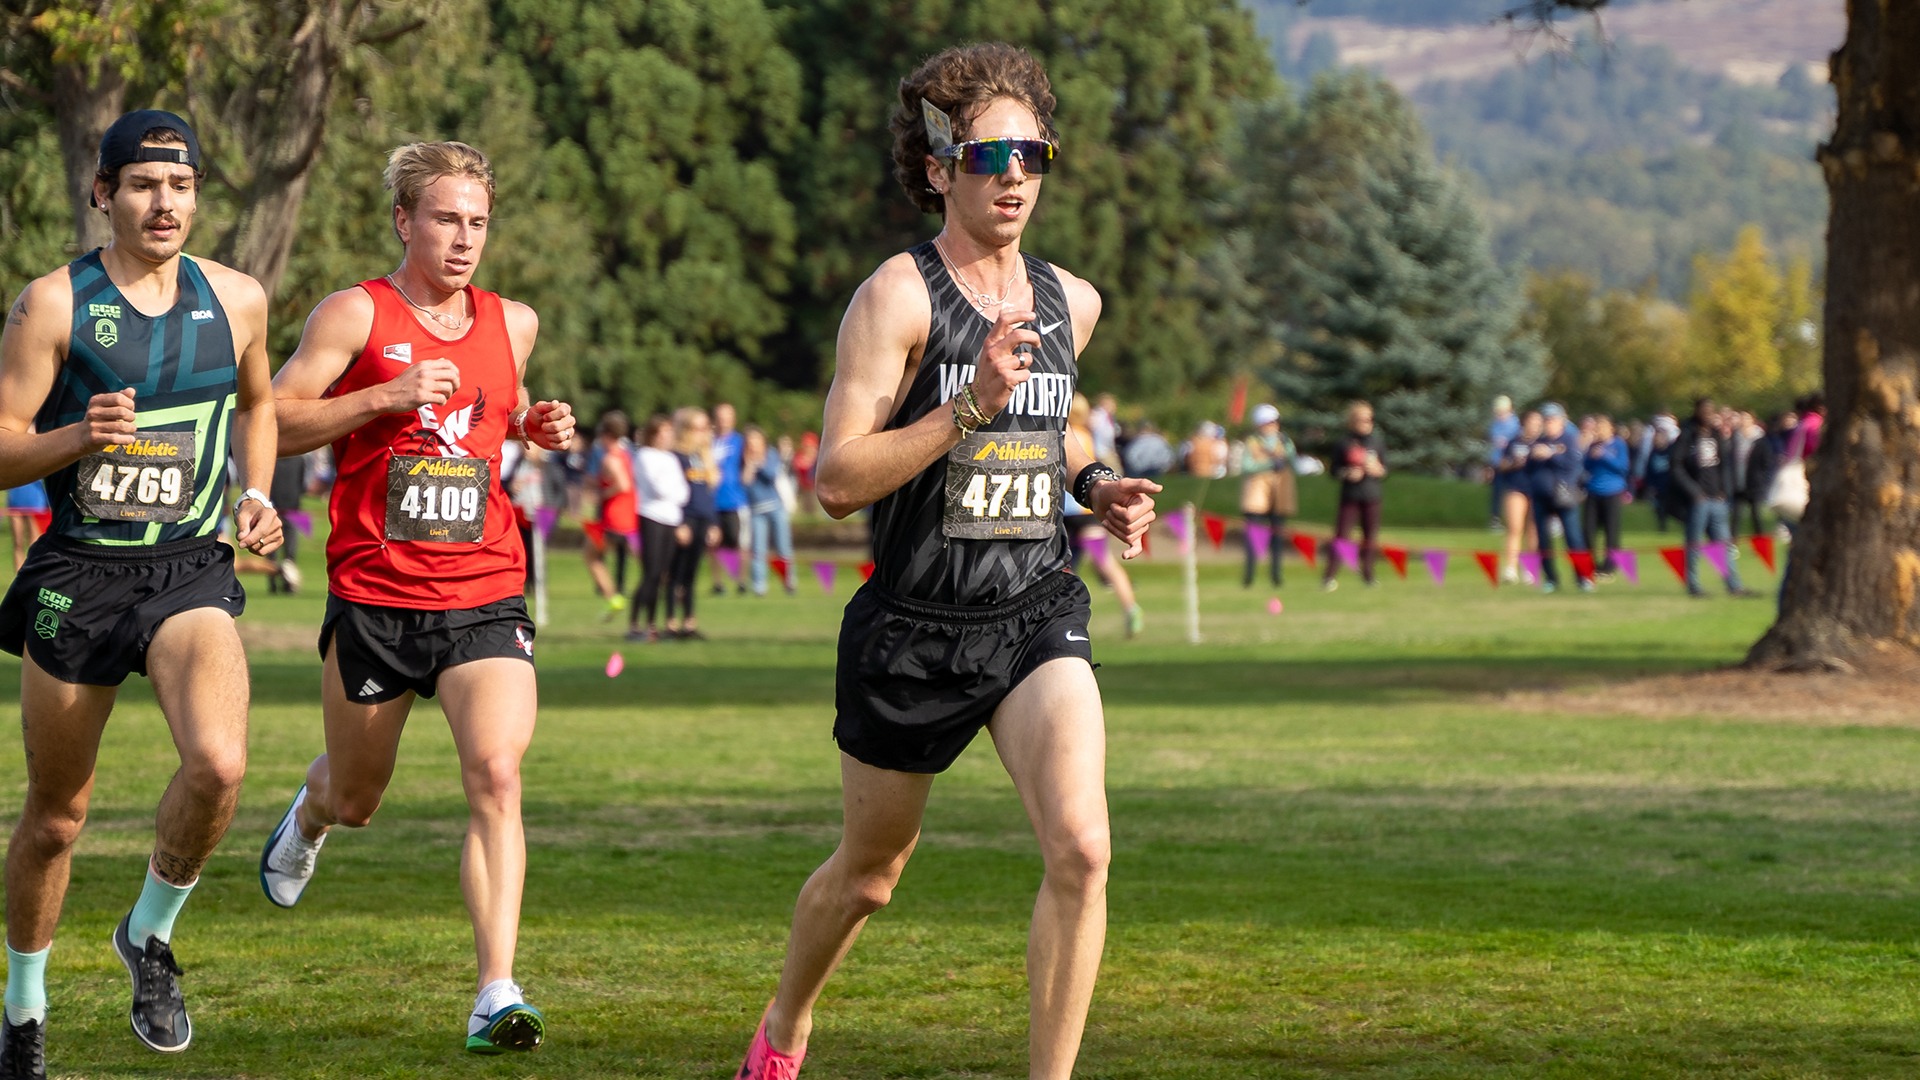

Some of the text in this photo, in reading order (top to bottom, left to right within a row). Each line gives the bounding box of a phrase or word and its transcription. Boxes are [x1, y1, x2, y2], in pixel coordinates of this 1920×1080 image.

[88, 303, 121, 314] CCC
[190, 309, 215, 320] BOA
[973, 440, 1048, 460] Athletic
[408, 459, 476, 477] Athletic
[91, 463, 182, 505] 4769
[400, 485, 479, 522] 4109
[962, 472, 1051, 518] 4718
[994, 526, 1022, 535] Live.TF
[38, 587, 73, 609] CCC
